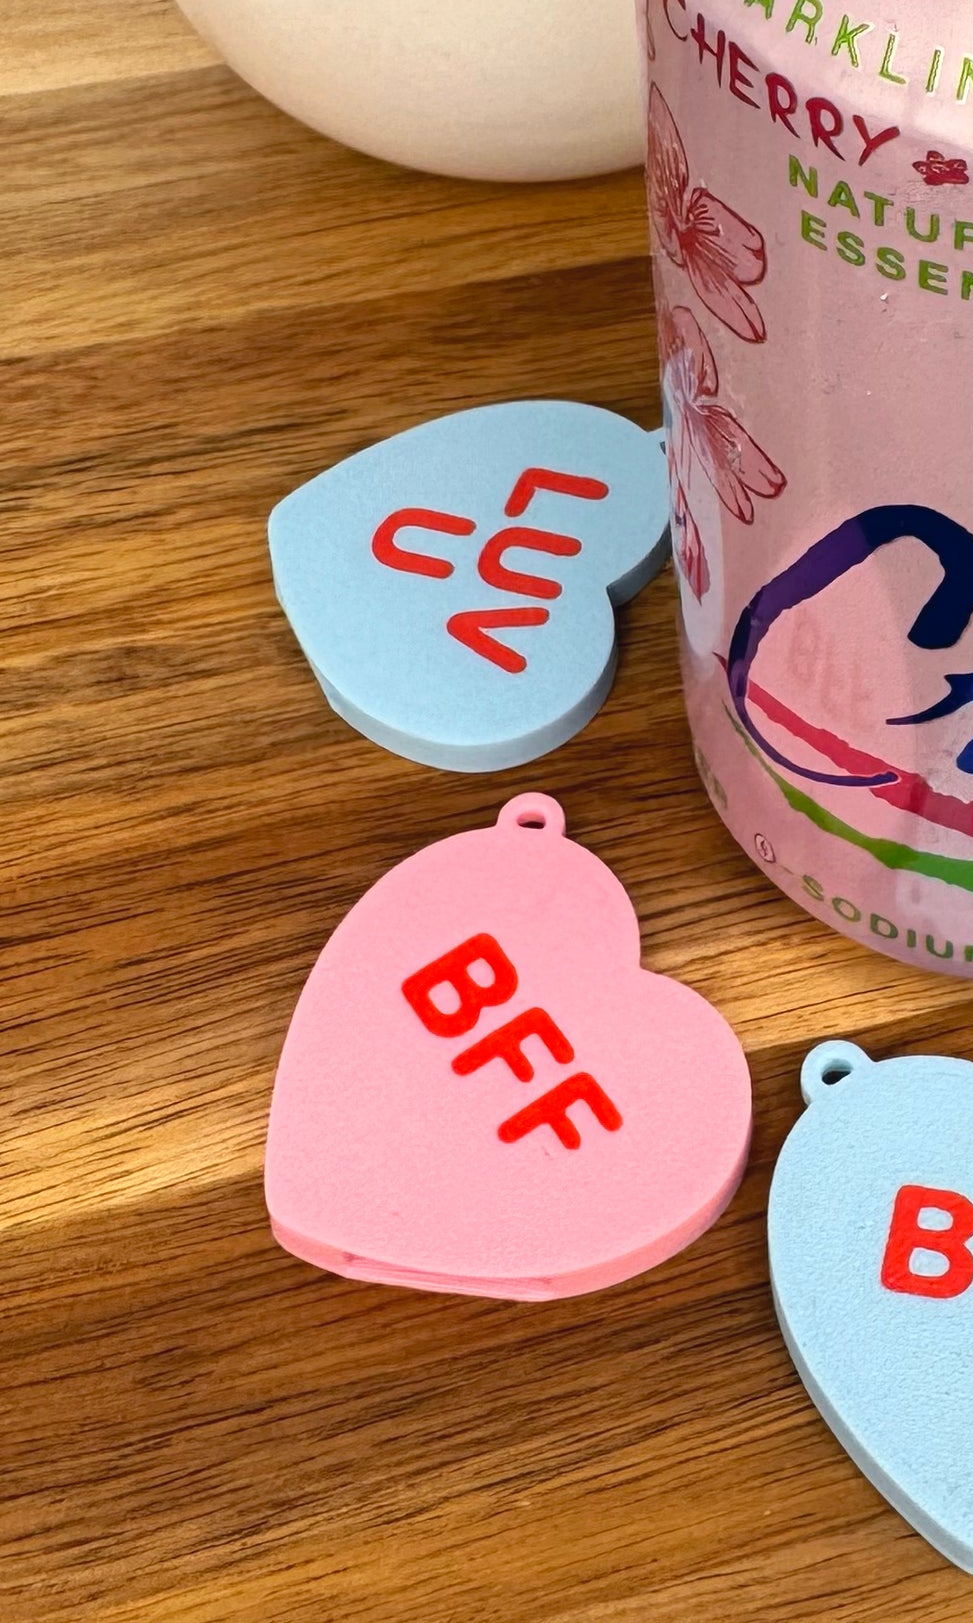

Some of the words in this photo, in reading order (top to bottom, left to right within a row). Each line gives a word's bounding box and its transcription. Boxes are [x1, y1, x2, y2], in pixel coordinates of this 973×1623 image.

[372, 507, 476, 579] U
[448, 467, 609, 674] LUV
[400, 932, 624, 1151] BFF
